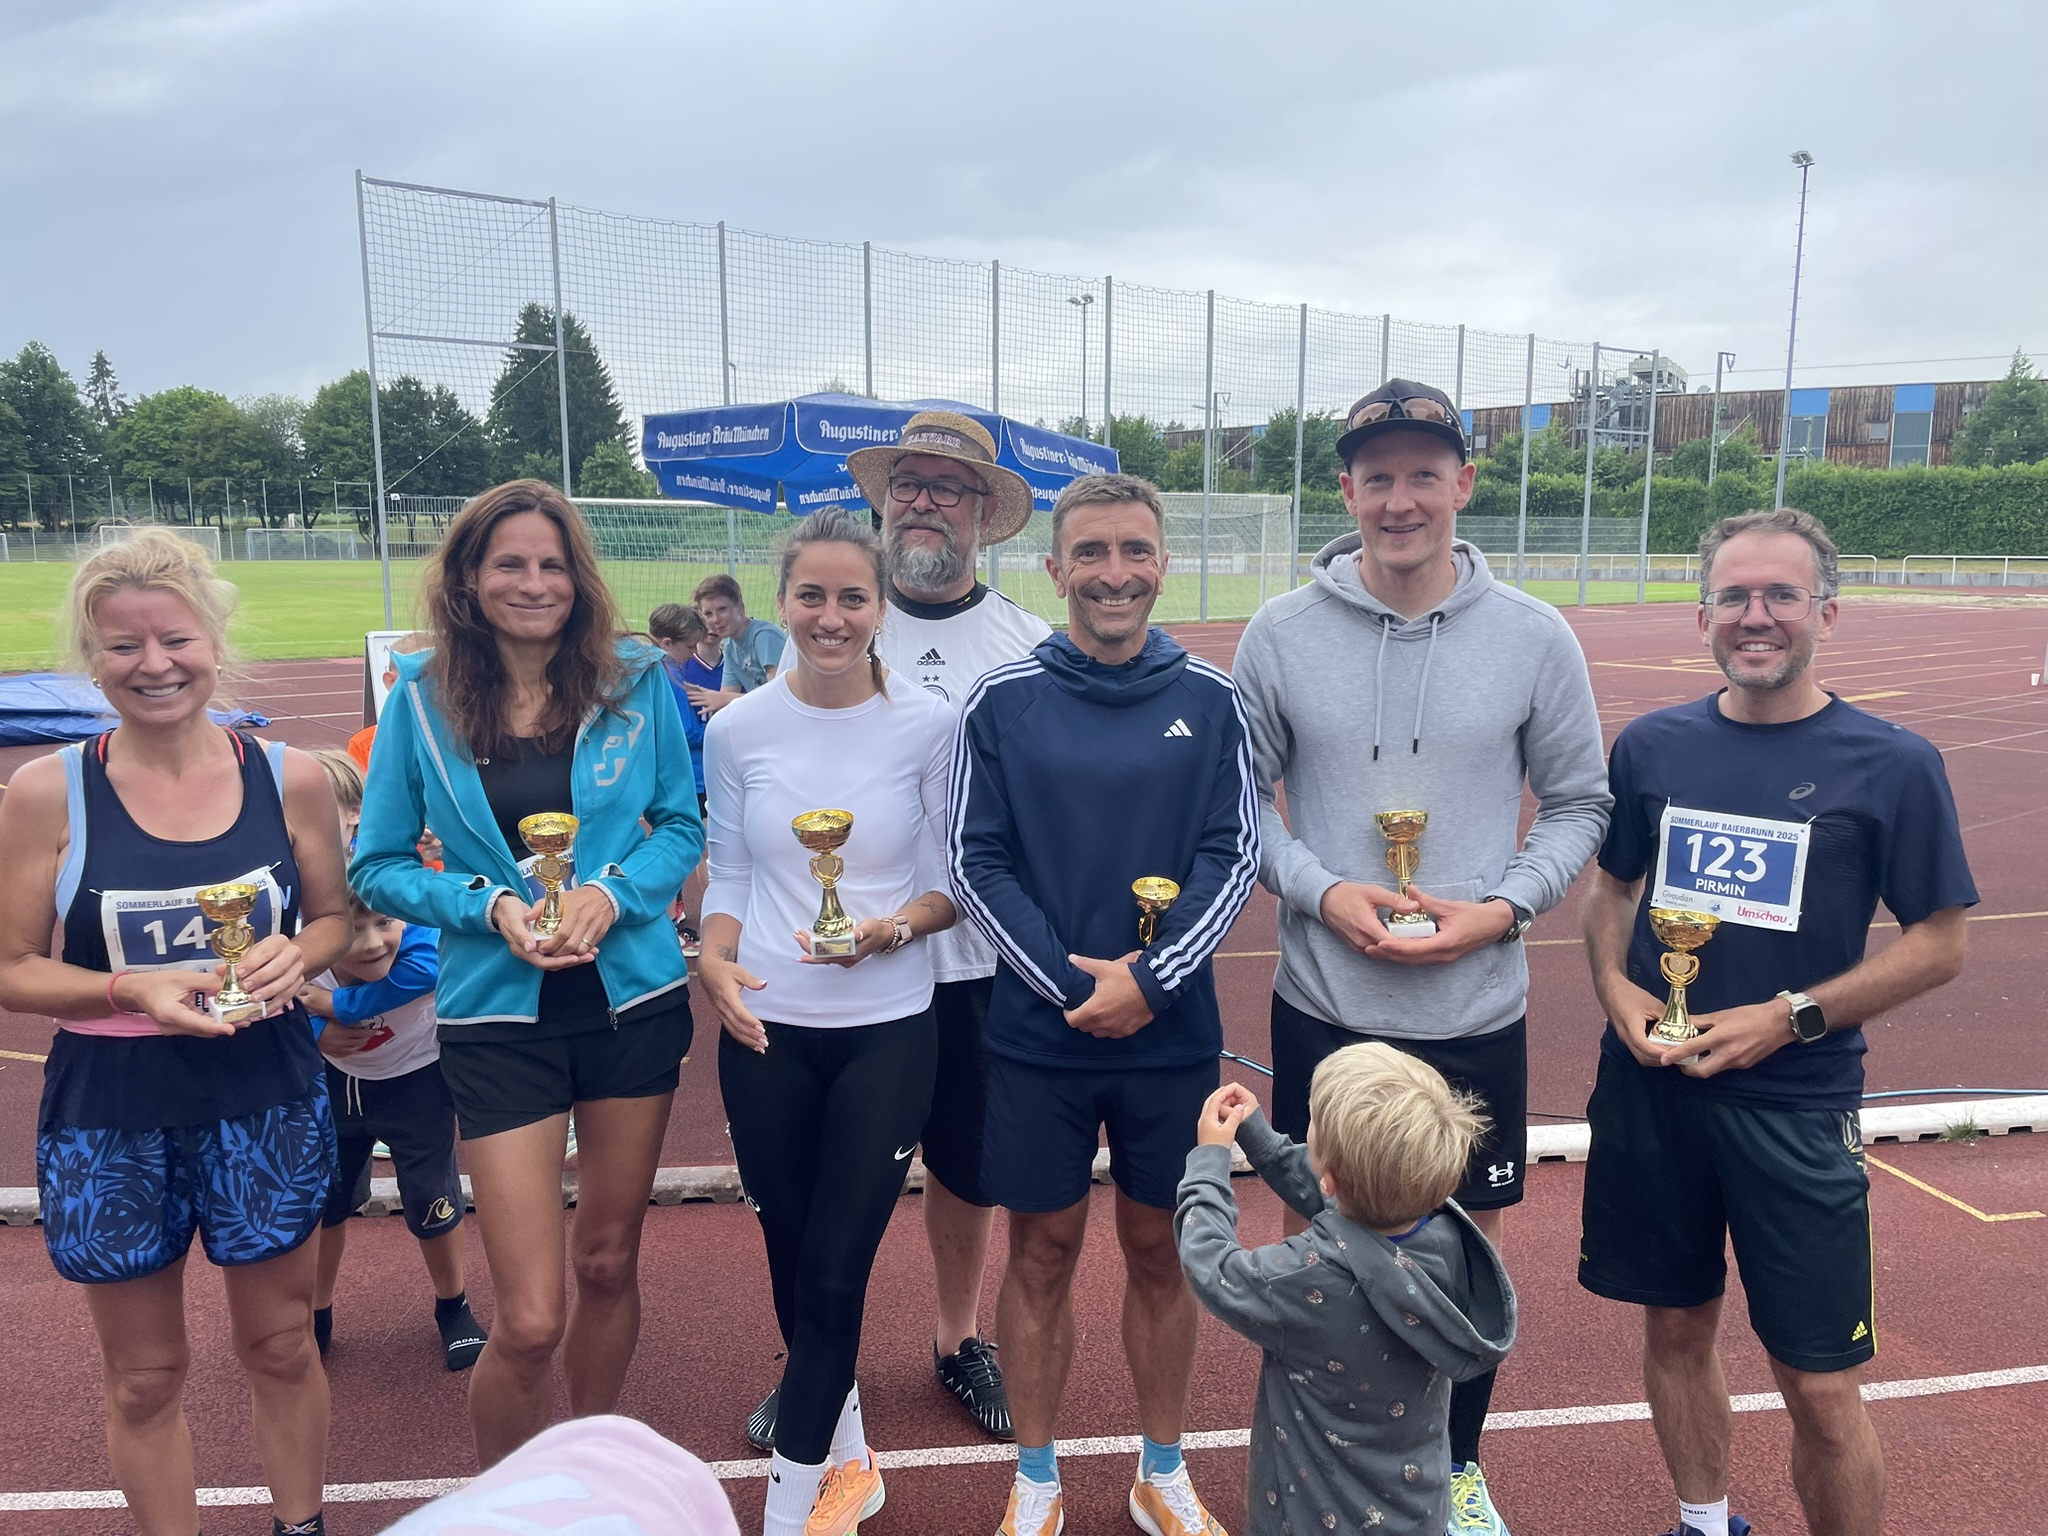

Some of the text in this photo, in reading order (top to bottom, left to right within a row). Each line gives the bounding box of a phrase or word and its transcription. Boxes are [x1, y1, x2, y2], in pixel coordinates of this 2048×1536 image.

[1670, 815, 1799, 841] SOMMERLAUF BAIERBRUNN 2025
[1686, 833, 1768, 883] 123
[116, 898, 183, 910] SOMMERLAUF
[253, 878, 267, 888] 25
[1662, 889, 1694, 903] Givaudan
[1695, 878, 1746, 897] PIRMIN
[1737, 905, 1788, 924] Umschau
[143, 914, 214, 955] 14
